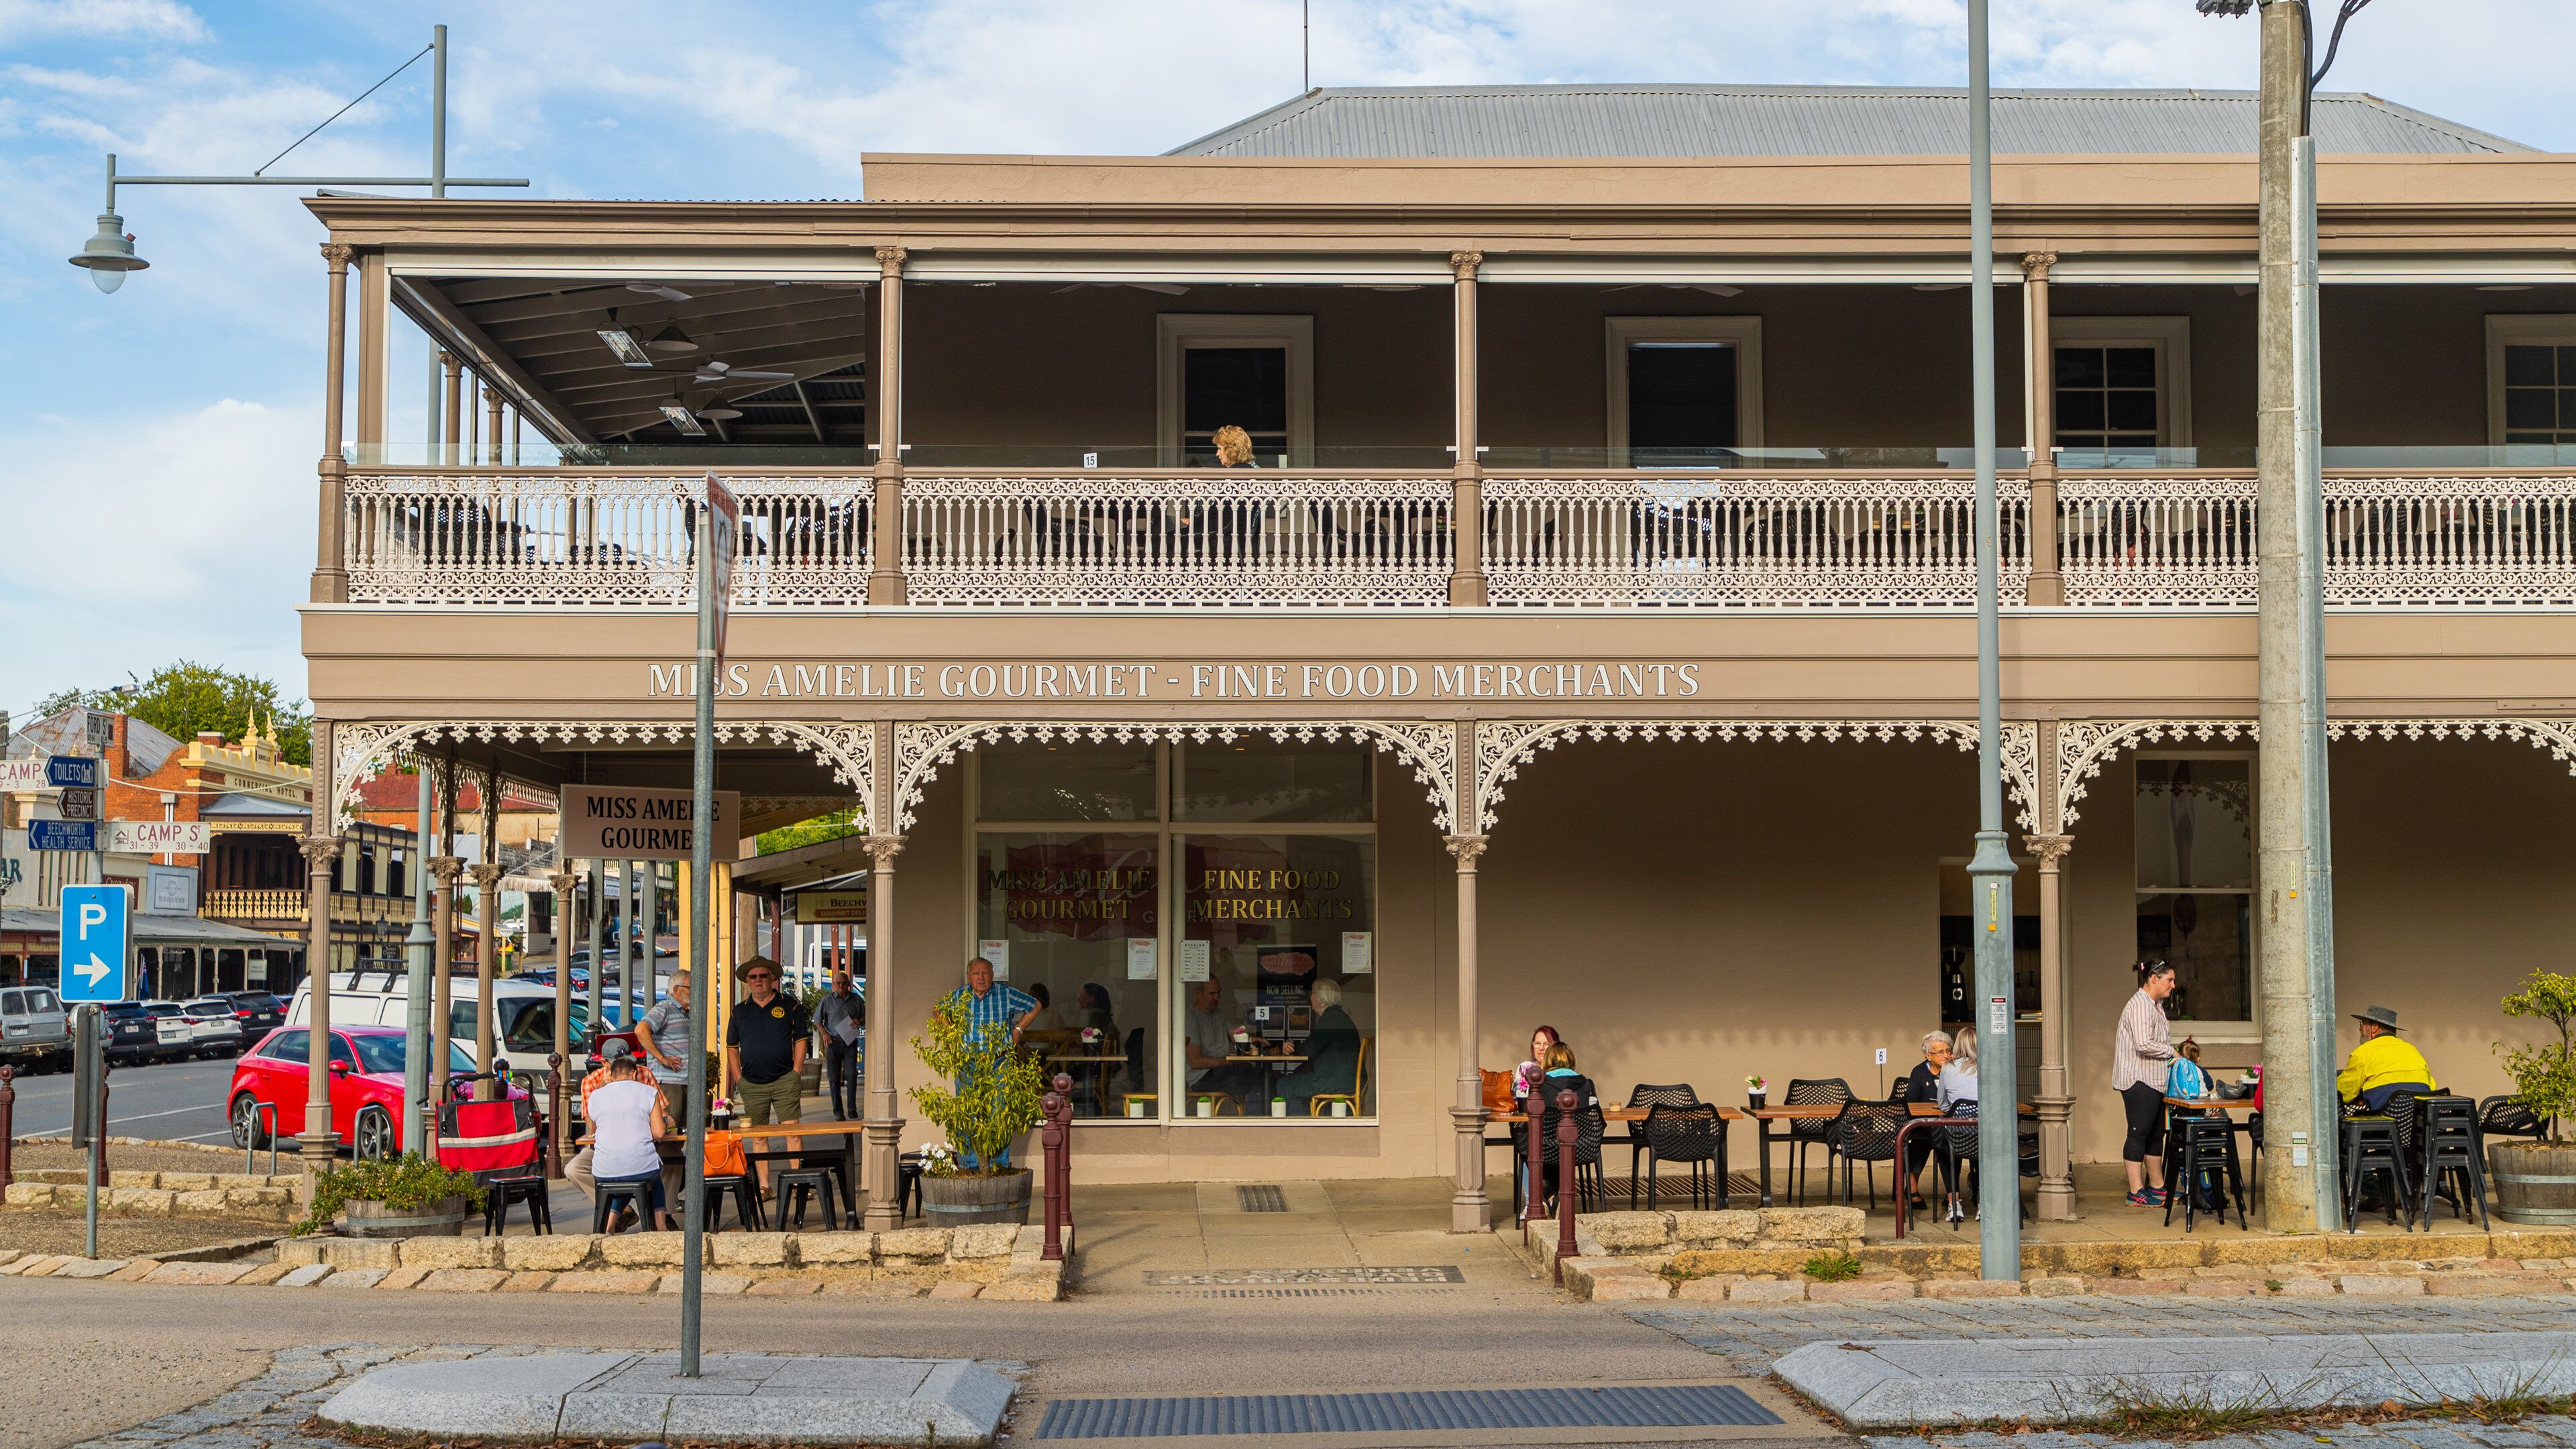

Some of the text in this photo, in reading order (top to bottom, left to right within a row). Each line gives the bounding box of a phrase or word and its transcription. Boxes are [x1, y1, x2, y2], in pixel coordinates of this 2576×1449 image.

[1086, 455, 1095, 466] 15
[760, 664, 926, 697] AMELIE
[939, 665, 1157, 697] GOURMET
[1191, 665, 1287, 697] FINE
[1301, 665, 1418, 697] FOOD
[1432, 663, 1699, 696] MERCHANTS
[87, 715, 101, 734] FORD
[54, 763, 80, 781] TOILETS
[36, 780, 46, 788] 28
[68, 790, 93, 803] HISTORIC
[67, 804, 93, 818] PRECINCT
[586, 796, 720, 822] MISS AMEE
[47, 822, 85, 833] BEECHWORTH
[138, 824, 182, 842] CAMP
[189, 824, 201, 842] ST
[42, 835, 91, 850] HEALTH SERVICE
[129, 841, 138, 850] 31
[149, 841, 159, 850] 39
[176, 841, 186, 851] 30
[198, 841, 209, 851] 40
[601, 826, 692, 850] GOURME
[985, 870, 1151, 891] MISS AMELIE
[1204, 869, 1341, 890] FINE FOOD
[1002, 900, 1133, 920] GOURMET
[1193, 899, 1354, 920] MERCHANTS
[80, 904, 107, 941] P
[1267, 985, 1279, 995] NOW
[1259, 1008, 1265, 1018] 5
[1879, 1051, 1883, 1061] 6
